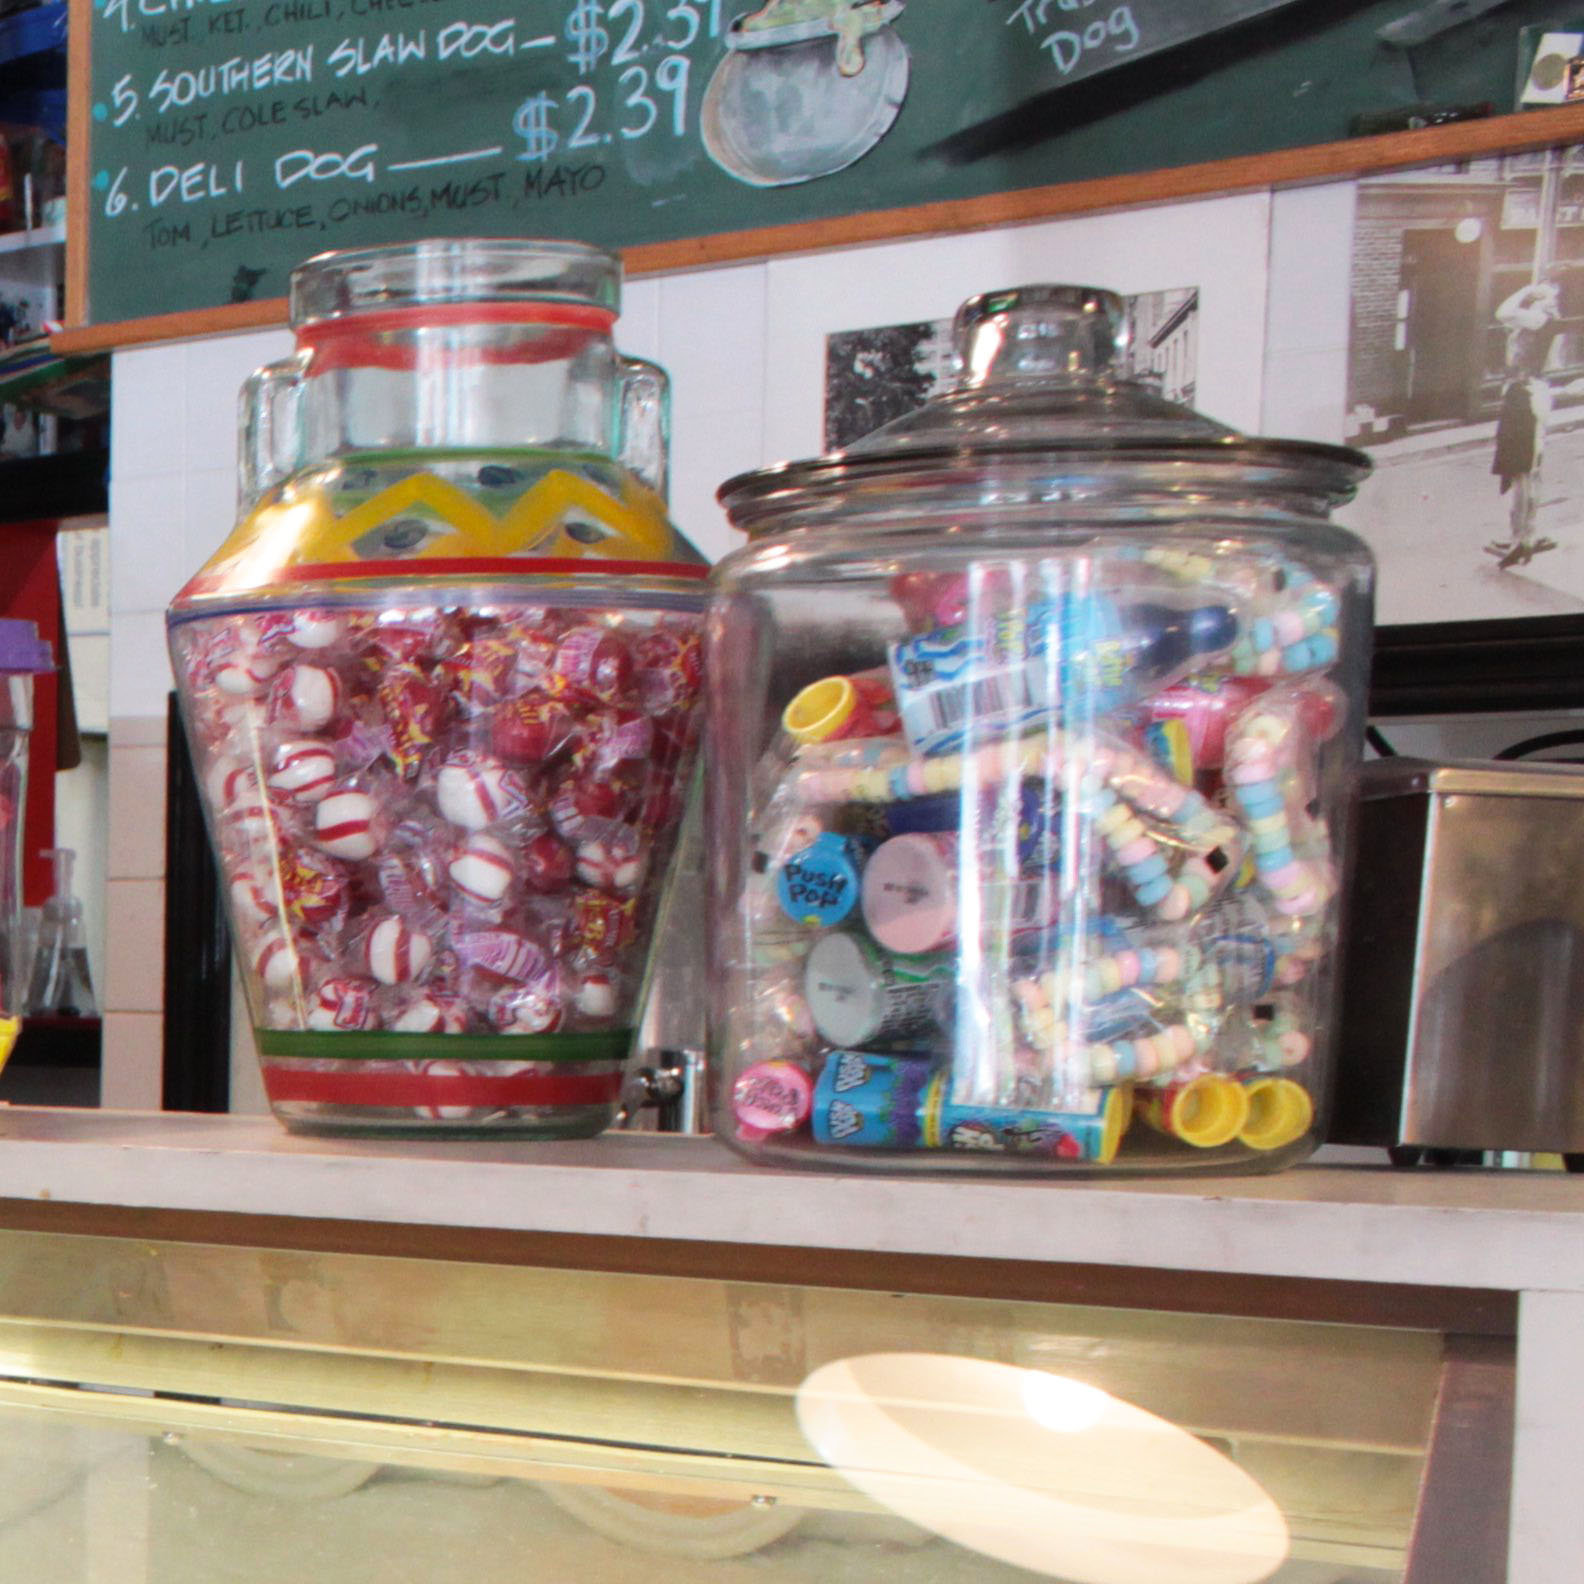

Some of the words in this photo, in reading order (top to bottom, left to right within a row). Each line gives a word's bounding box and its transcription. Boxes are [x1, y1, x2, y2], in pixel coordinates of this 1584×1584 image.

[148, 44, 314, 114] SOUTHERN
[327, 29, 426, 77] SLAW
[1039, 5, 1140, 75] Dog
[149, 161, 243, 208] DELI
[274, 143, 379, 190] DOG
[512, 54, 691, 163] $2.39
[221, 103, 287, 134] COLE
[524, 165, 606, 199] MAYO
